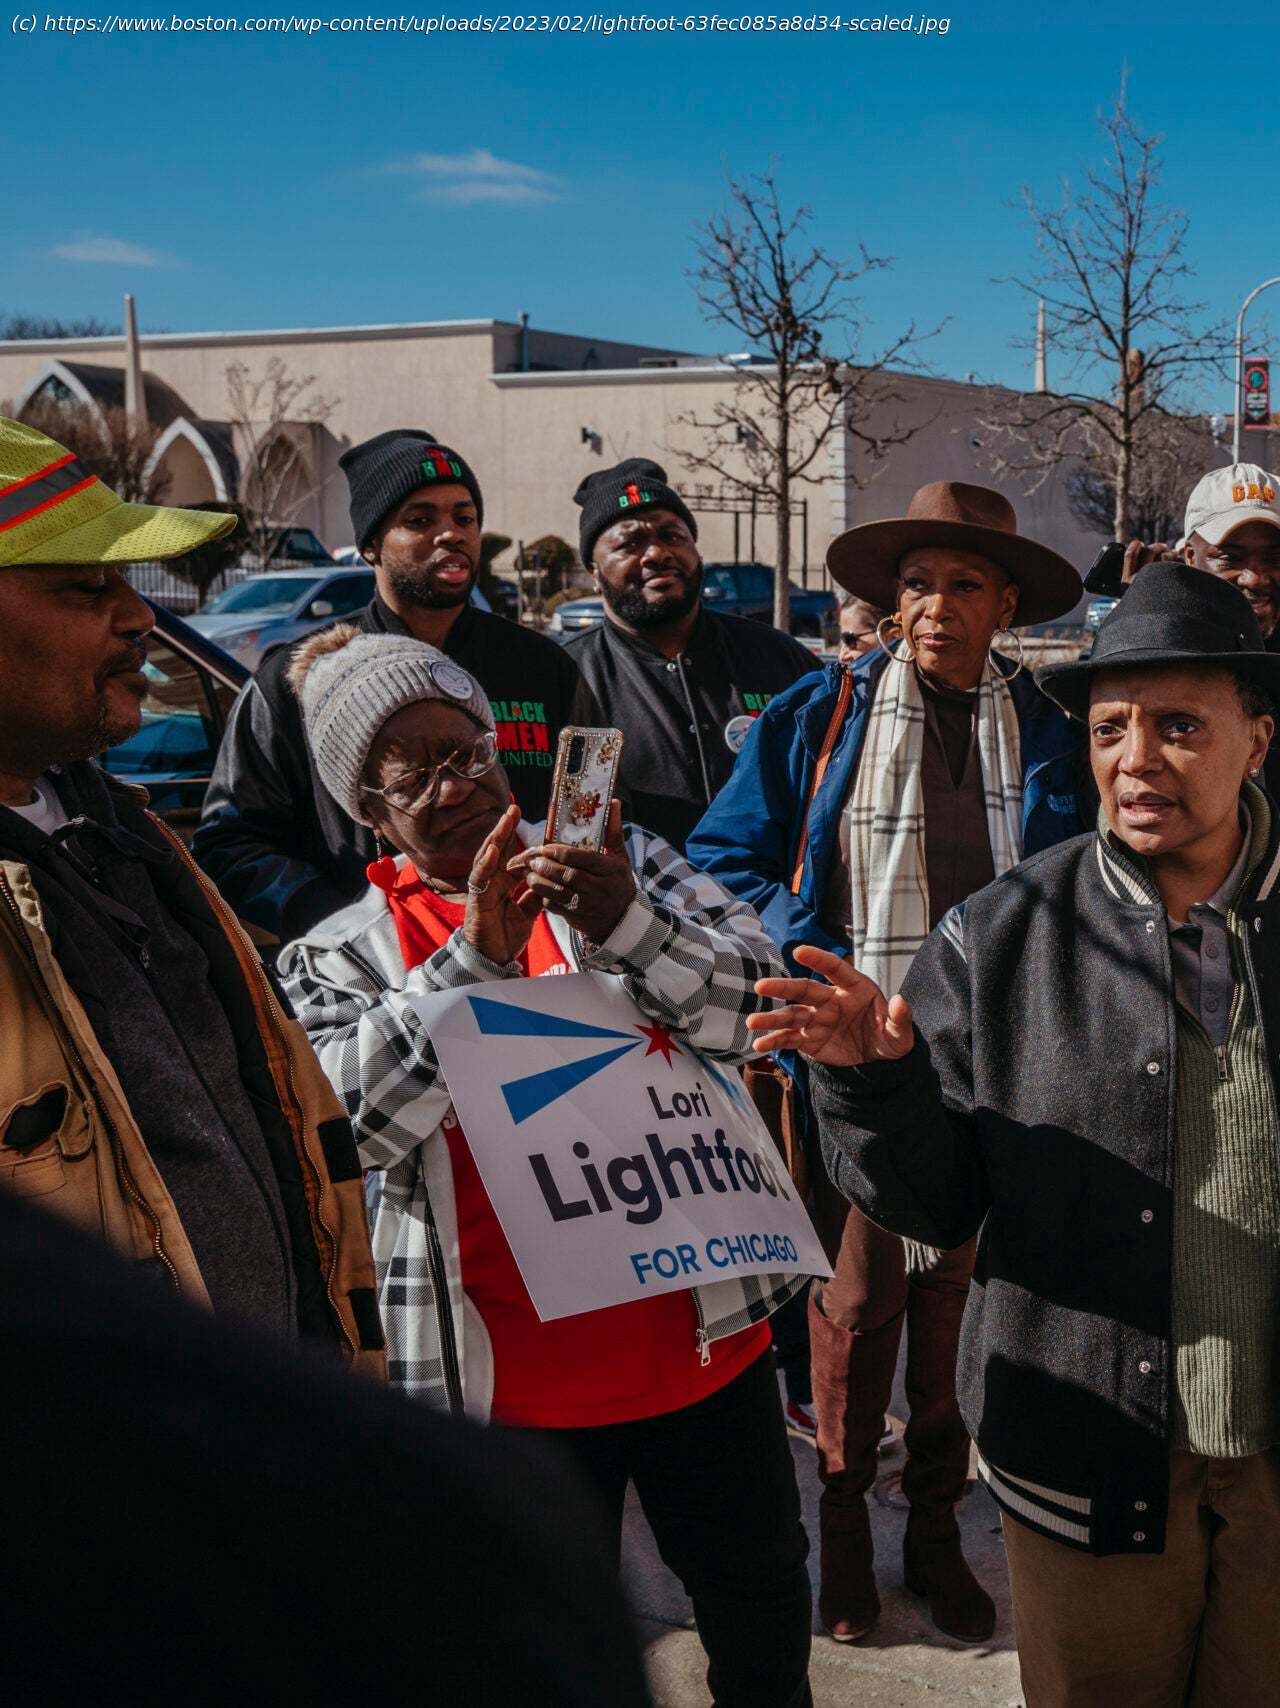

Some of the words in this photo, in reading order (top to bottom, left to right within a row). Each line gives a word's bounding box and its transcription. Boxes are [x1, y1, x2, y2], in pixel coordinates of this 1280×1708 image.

[421, 459, 462, 479] BMU
[490, 701, 547, 723] BLACK
[495, 721, 549, 752] MEN
[496, 751, 553, 768] UNITED
[647, 1082, 712, 1120] Lori
[528, 1128, 790, 1224] Lightfoot
[630, 1244, 702, 1284] FOR
[705, 1233, 798, 1268] CHICAGO
